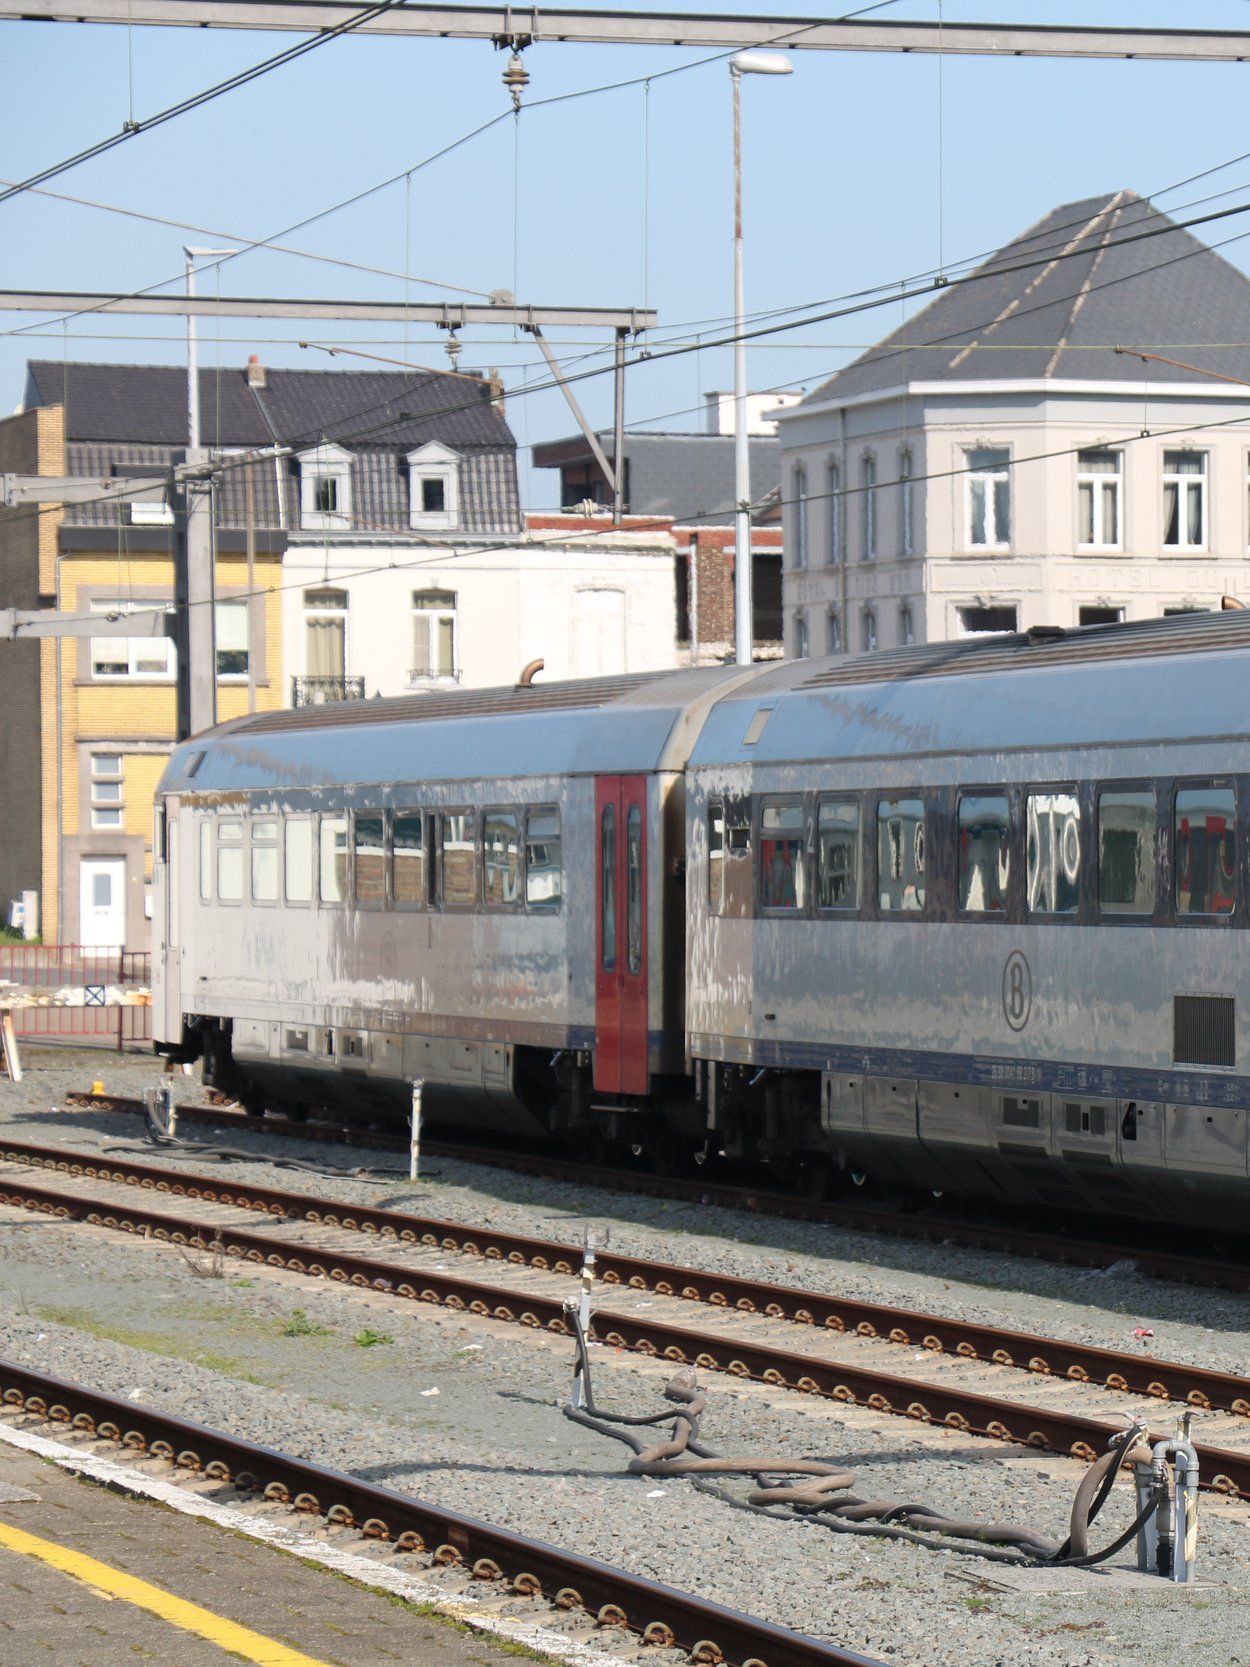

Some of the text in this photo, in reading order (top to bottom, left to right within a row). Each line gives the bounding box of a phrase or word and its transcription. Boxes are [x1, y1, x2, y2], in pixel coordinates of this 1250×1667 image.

[1067, 568, 1160, 589] HOTEL
[1186, 568, 1218, 589] DU
[807, 816, 815, 853] 2
